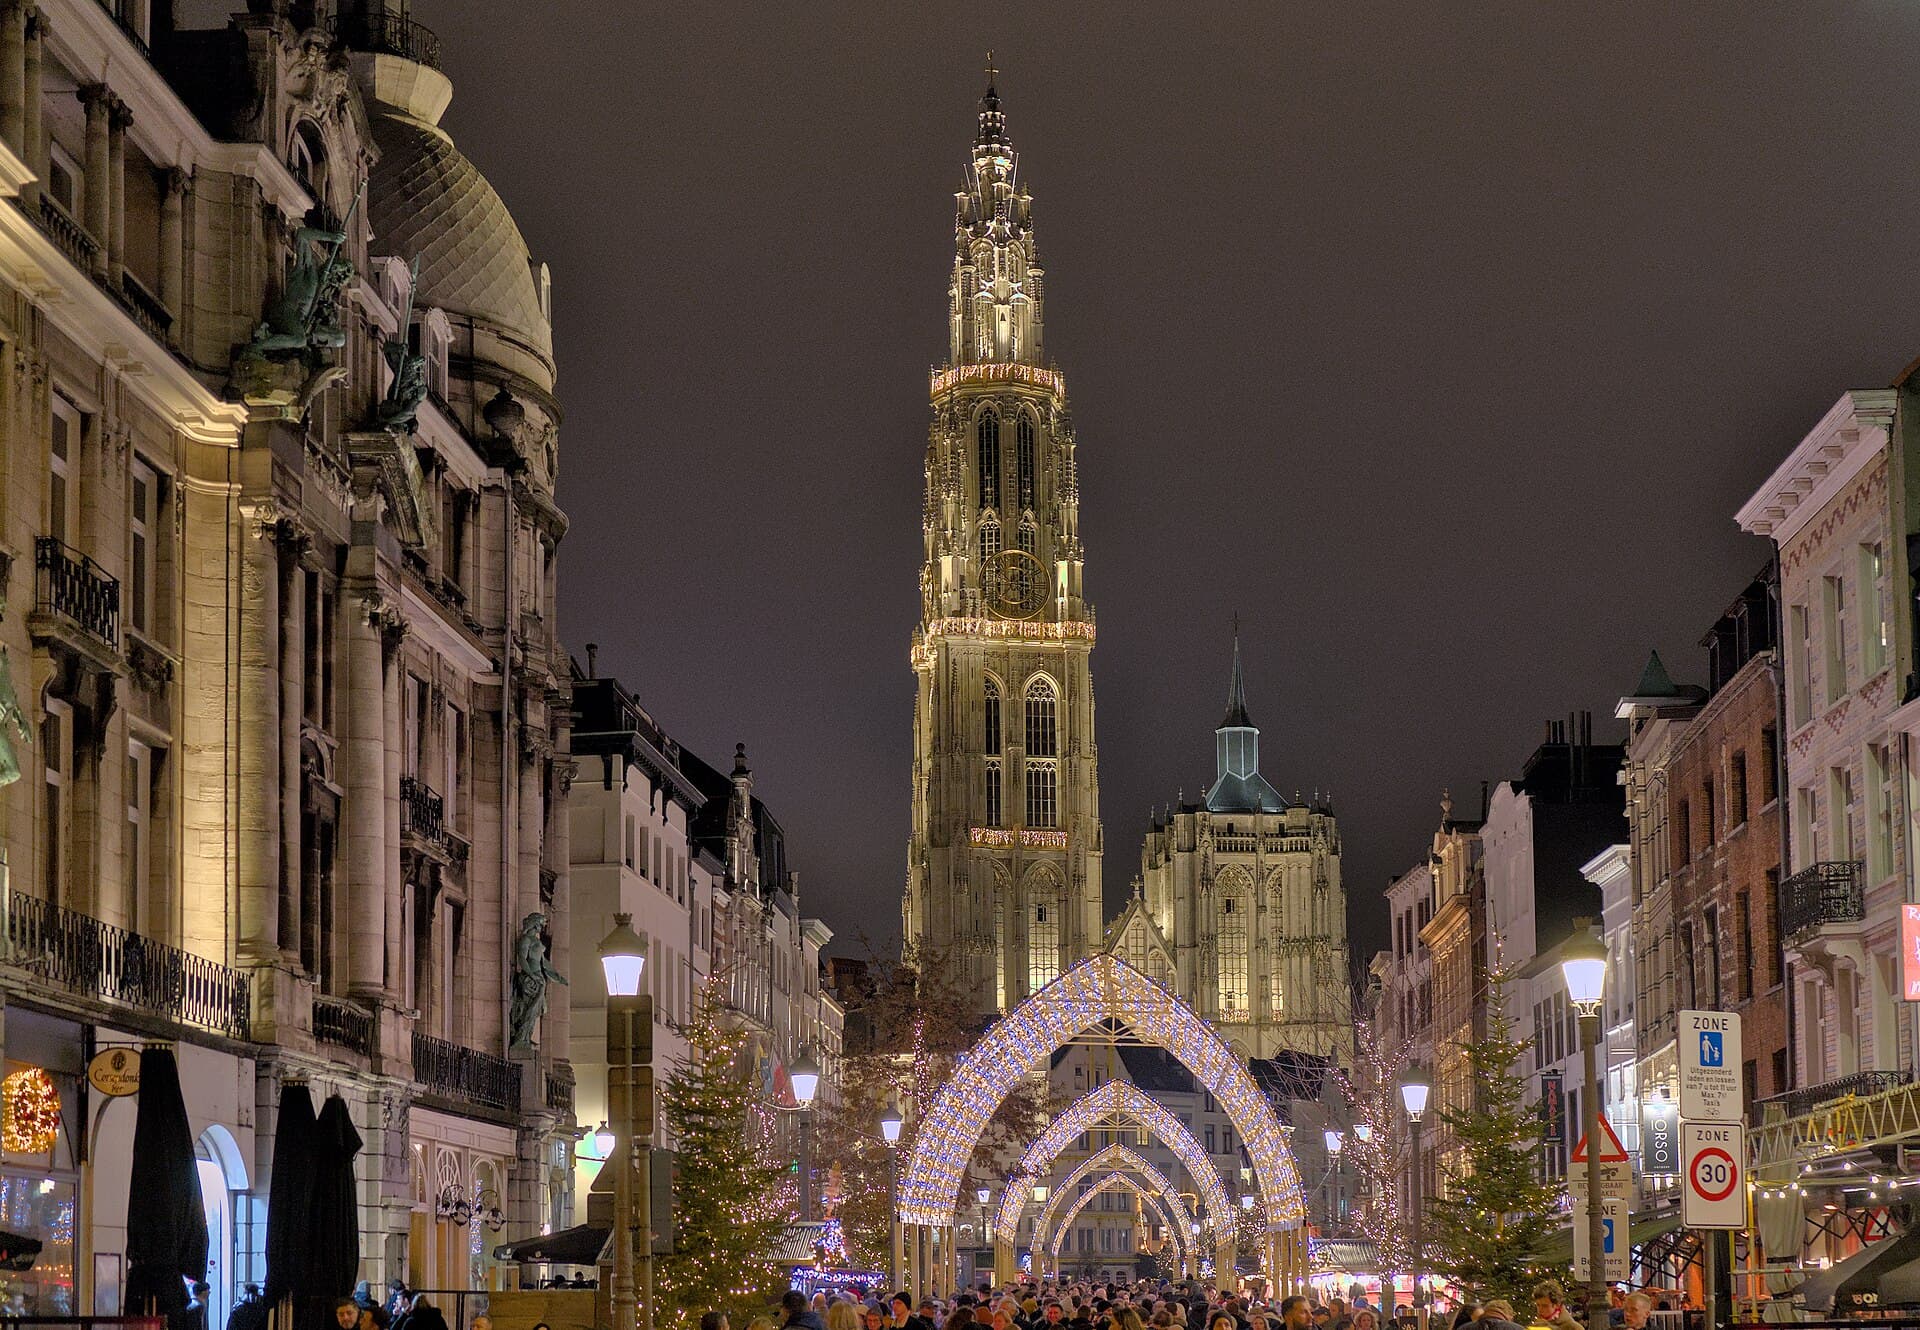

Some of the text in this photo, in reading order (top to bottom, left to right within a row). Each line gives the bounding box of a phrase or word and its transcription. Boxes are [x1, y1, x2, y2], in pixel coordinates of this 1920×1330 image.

[1693, 1017, 1729, 1031] ZONE
[1690, 1067, 1732, 1075] Uitgezonderd
[1654, 1119, 1668, 1163] ORSO
[1697, 1130, 1729, 1141] ZONE
[1701, 1164, 1726, 1183] 30
[1585, 1205, 1617, 1215] ZNE
